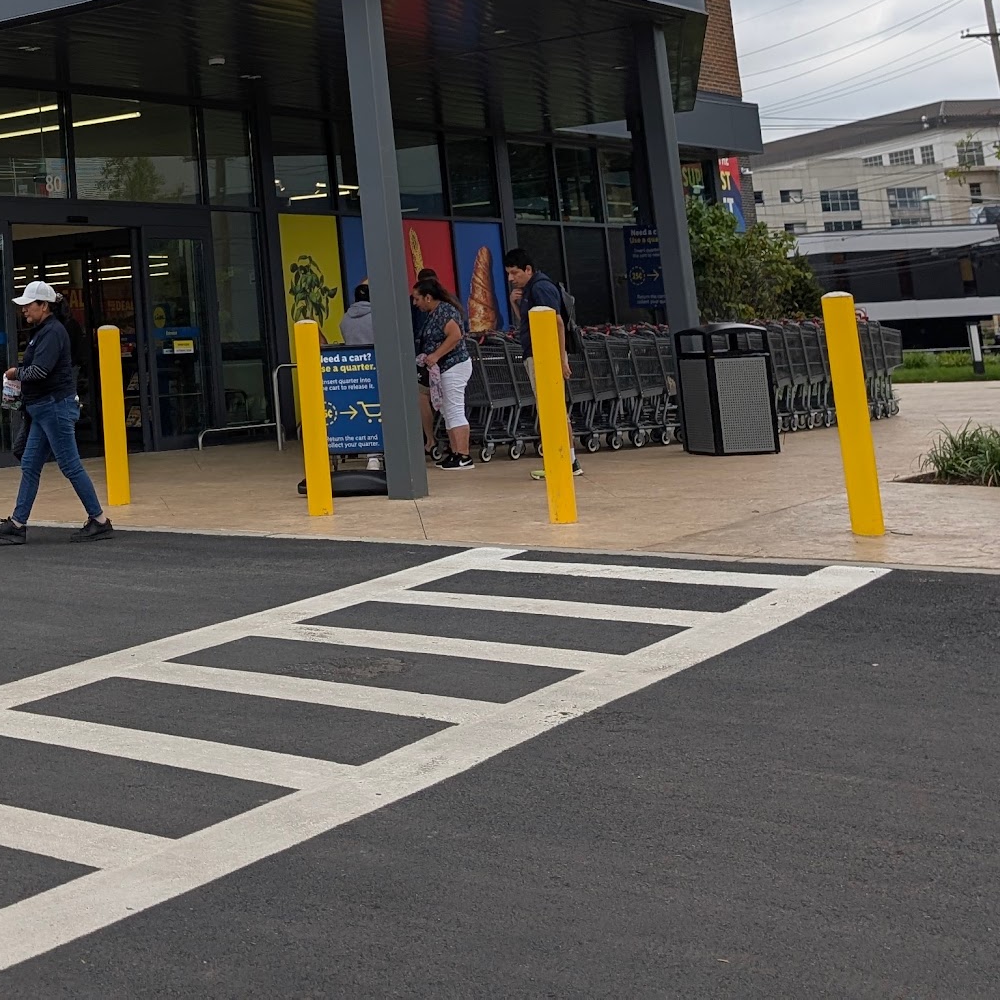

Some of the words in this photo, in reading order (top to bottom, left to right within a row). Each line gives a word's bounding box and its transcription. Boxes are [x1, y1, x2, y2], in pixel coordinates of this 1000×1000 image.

[46, 175, 62, 192] 80
[720, 170, 731, 191] ST
[630, 228, 647, 236] Need
[647, 236, 659, 244] qua
[342, 355, 348, 363] a
[349, 353, 372, 362] cart?
[340, 363, 376, 374] quarter.
[358, 441, 380, 449] quarter.
